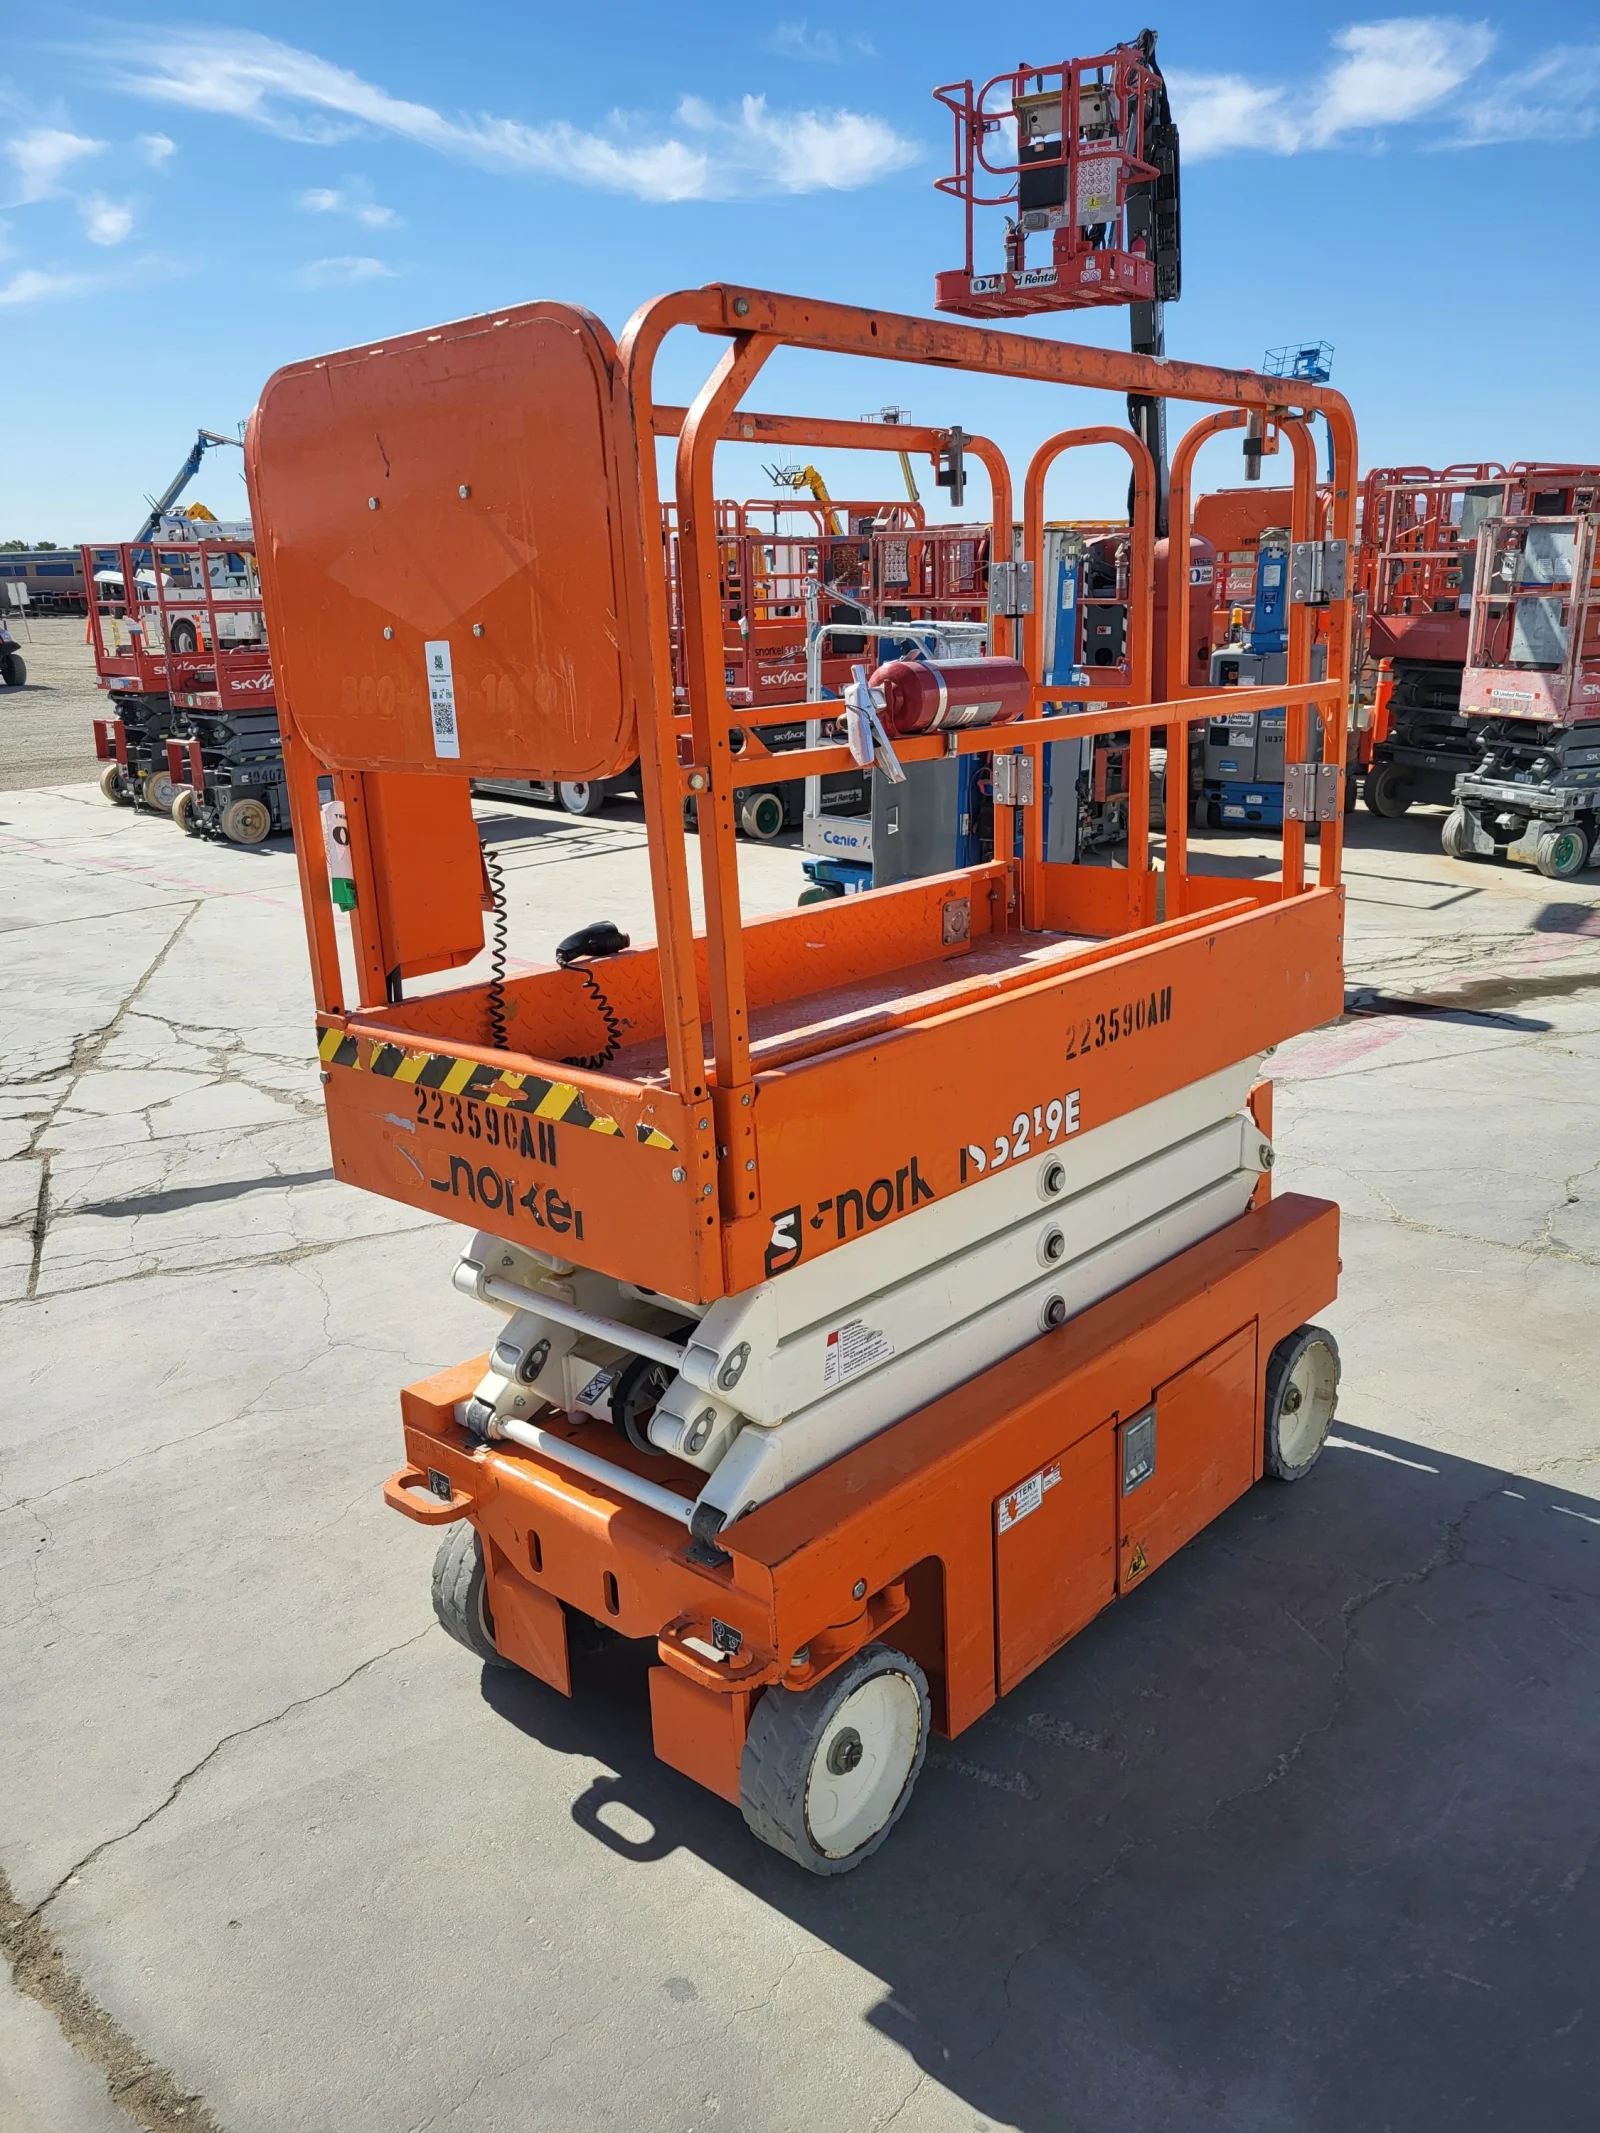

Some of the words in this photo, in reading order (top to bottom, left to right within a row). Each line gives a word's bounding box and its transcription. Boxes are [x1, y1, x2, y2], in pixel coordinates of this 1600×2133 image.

[1025, 271, 1057, 285] Rental
[1228, 713, 1250, 721] United
[774, 730, 805, 741] SKYJACK
[820, 795, 837, 805] nited
[1066, 986, 1172, 1061] 223590AH
[1004, 1479, 1037, 1508] BATTERY
